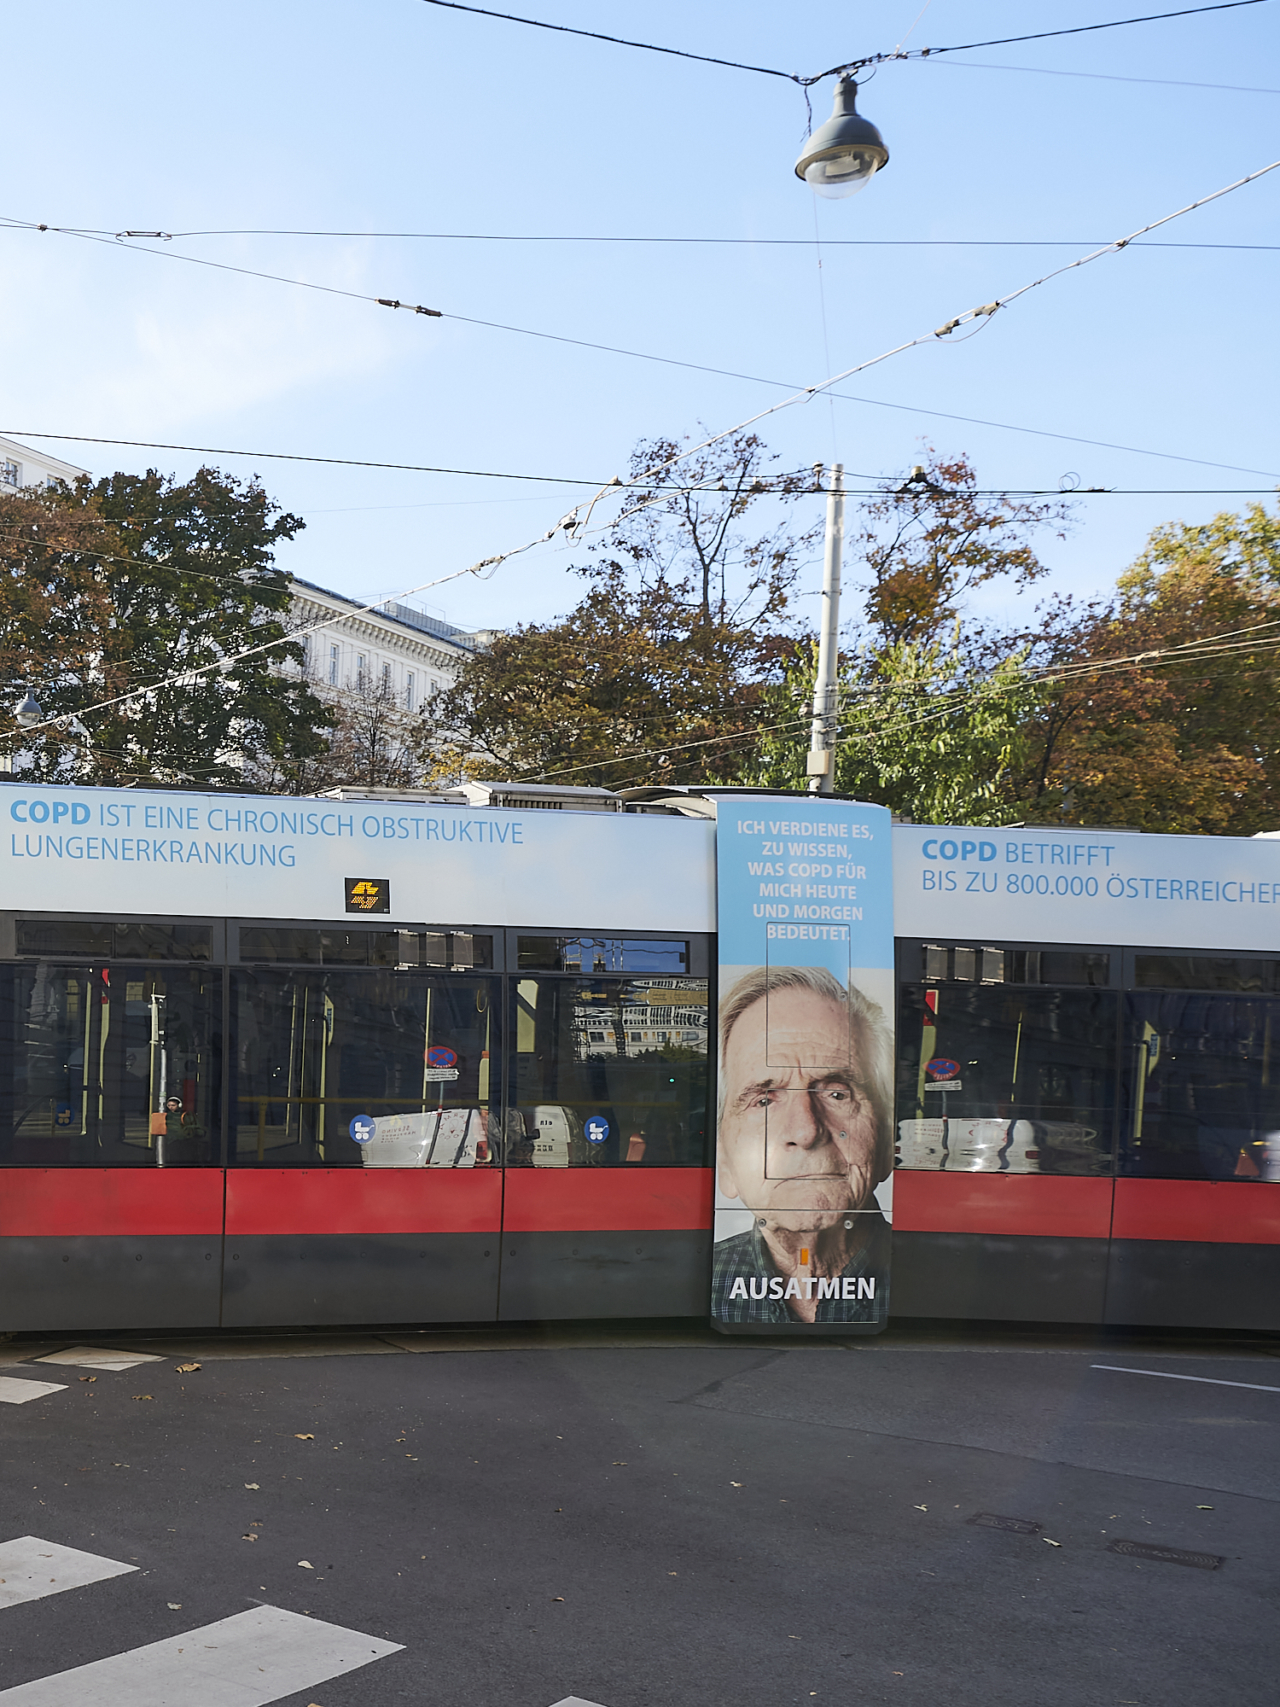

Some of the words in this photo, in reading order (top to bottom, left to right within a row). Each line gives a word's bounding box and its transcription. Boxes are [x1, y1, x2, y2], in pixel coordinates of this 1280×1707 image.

[10, 799, 91, 825] COPD
[99, 803, 136, 828] IST
[144, 805, 200, 830] EINE
[207, 808, 354, 837] CHRONISCH
[362, 815, 524, 845] OBSTRUKTIVE
[737, 820, 765, 835] ICH
[769, 821, 849, 838] VERDIENE
[852, 824, 874, 841] ES,
[11, 834, 296, 867] LUNGENERKRANKUNG
[761, 841, 784, 856] ZU
[787, 842, 853, 860] WISSEN,
[922, 839, 998, 862] COPD
[1005, 842, 1115, 867] BETRIFFT
[747, 862, 785, 877] WAS
[788, 863, 833, 878] COPD
[836, 863, 867, 880] FÜR
[759, 883, 802, 898] MICH
[806, 884, 857, 900] HEUTE
[922, 869, 957, 892] BIS
[965, 871, 998, 893] ZU
[1006, 873, 1099, 897] 800.000
[753, 904, 790, 918] UND
[793, 905, 864, 921] MORGEN
[767, 924, 851, 941] BEDEUTET.
[729, 1276, 876, 1301] AUSATMEN
